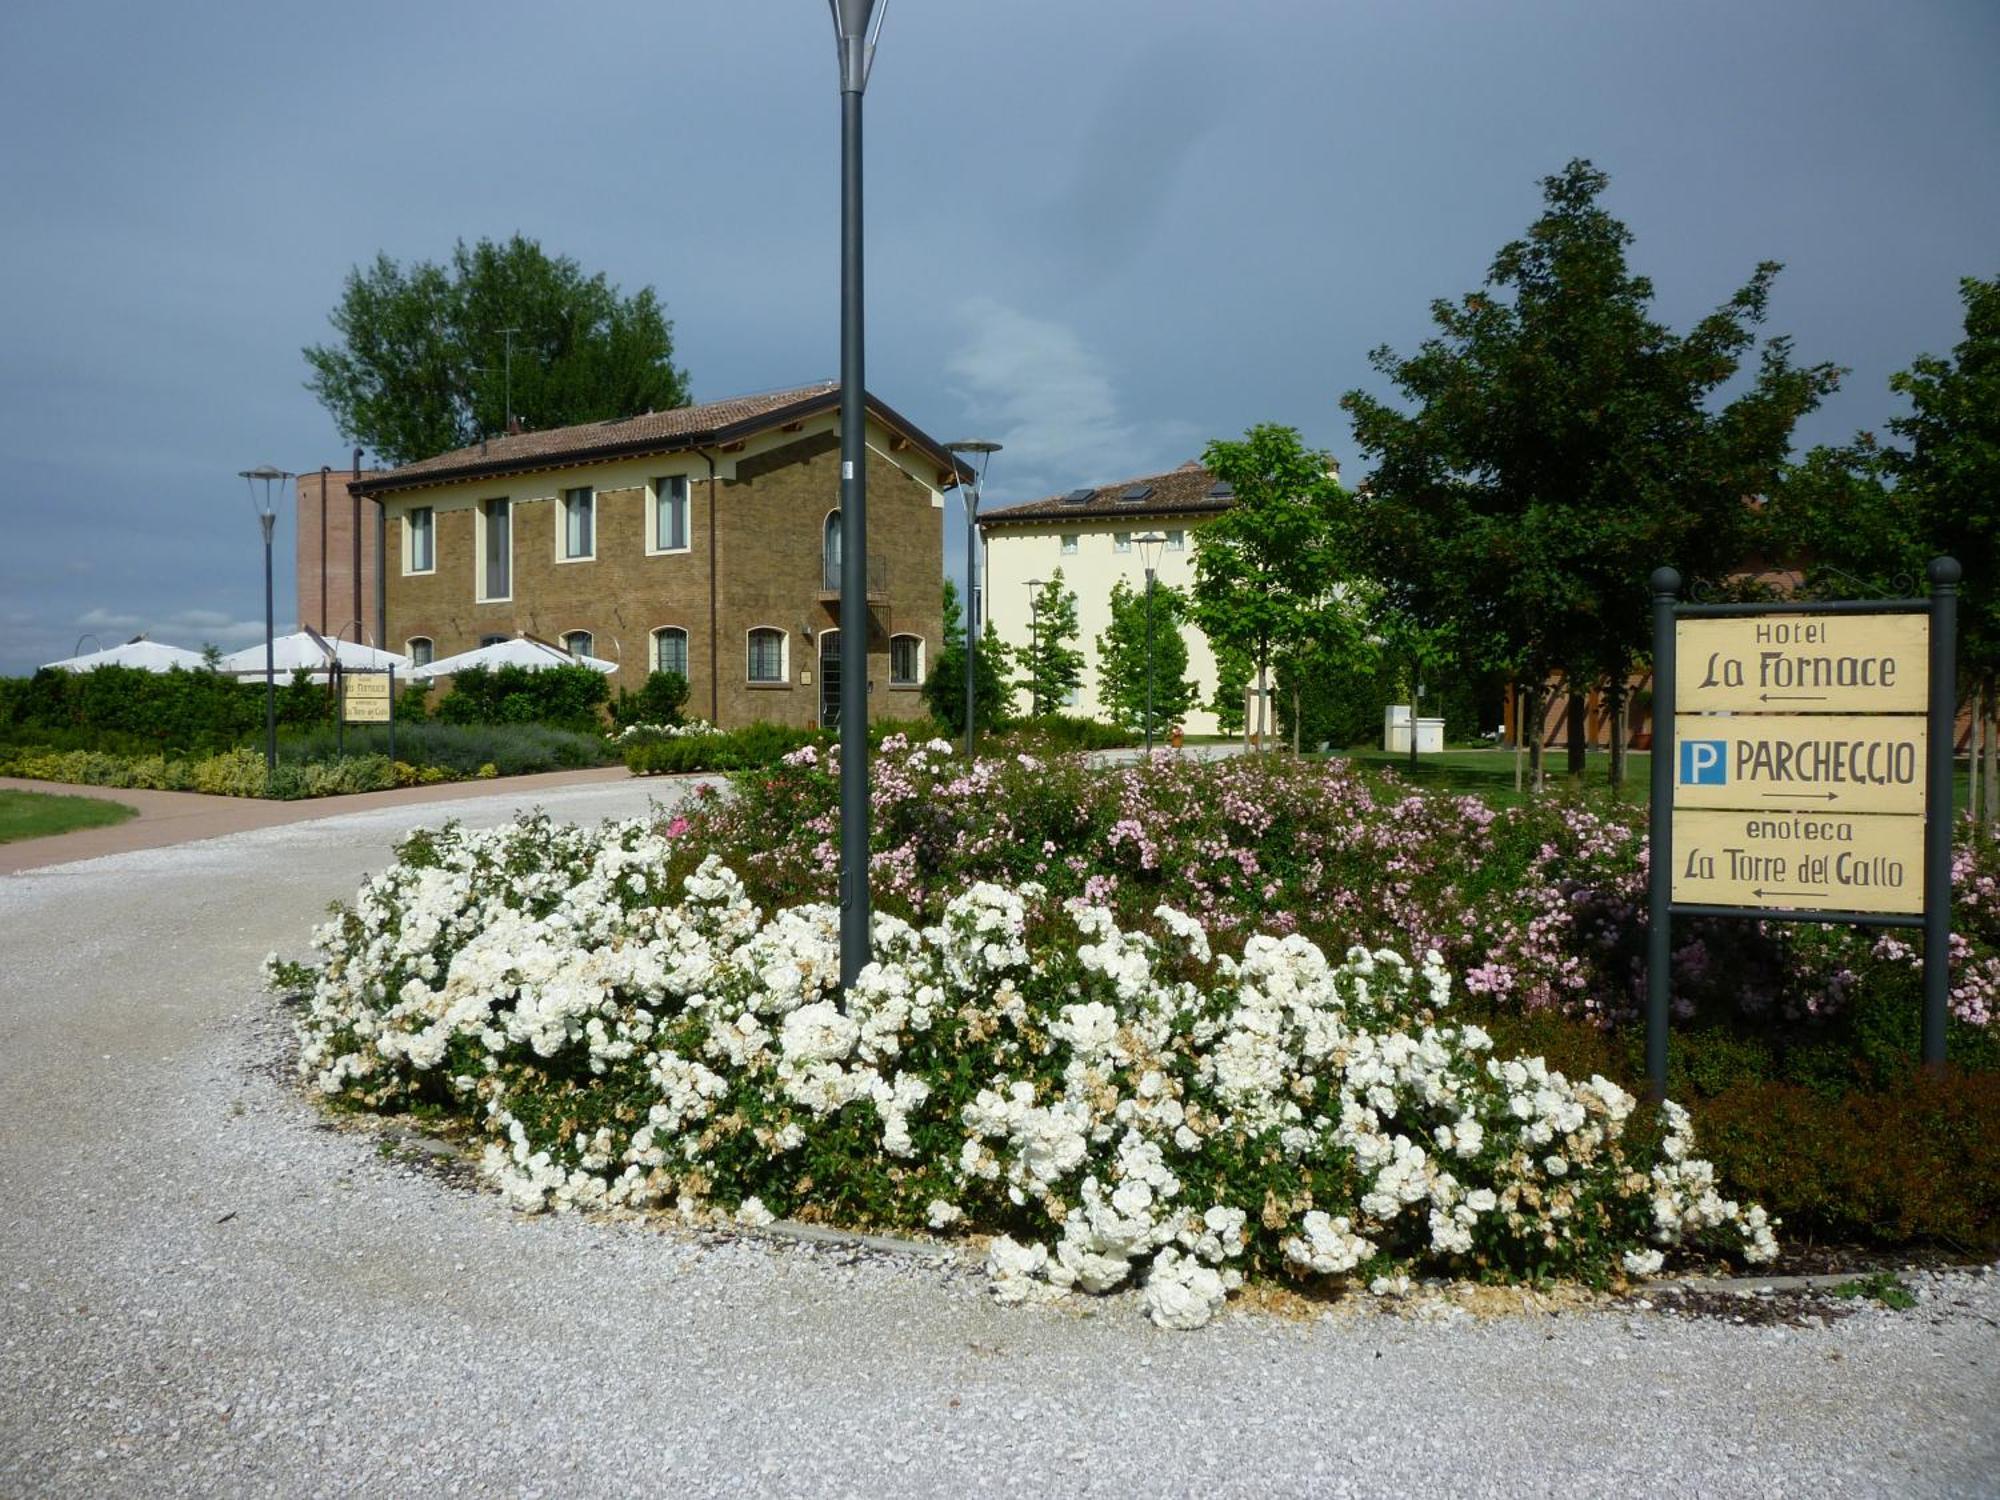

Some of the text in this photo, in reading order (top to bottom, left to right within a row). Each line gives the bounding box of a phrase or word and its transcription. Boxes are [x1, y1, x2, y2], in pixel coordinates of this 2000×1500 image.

[1756, 622, 1826, 644] Hotel
[1698, 651, 1896, 689] La Fornace
[1691, 740, 1915, 786] P PARCHEGGIO
[1746, 818, 1854, 841] enoteca
[1684, 848, 1904, 888] La Torre del Gallo
